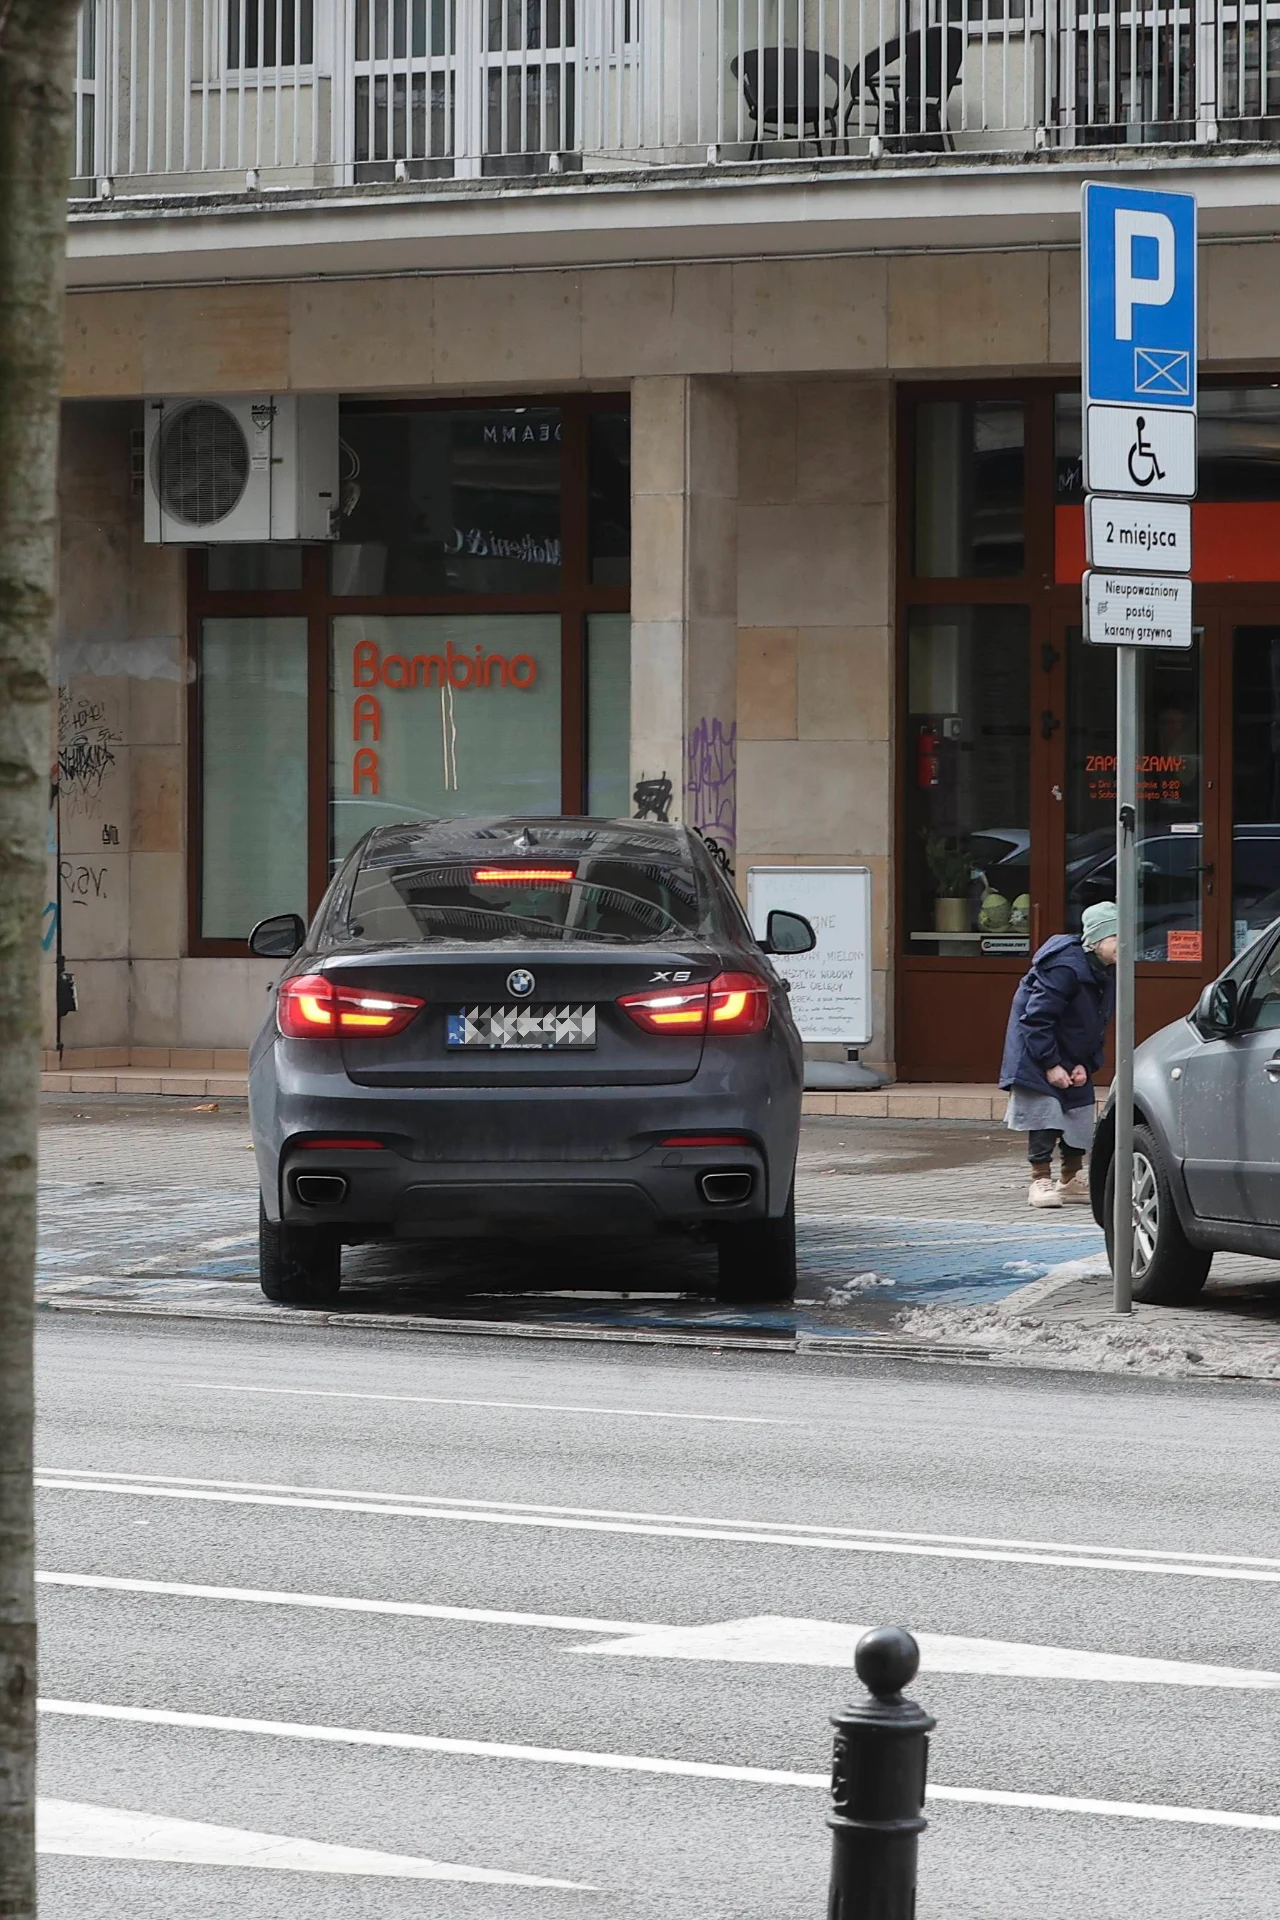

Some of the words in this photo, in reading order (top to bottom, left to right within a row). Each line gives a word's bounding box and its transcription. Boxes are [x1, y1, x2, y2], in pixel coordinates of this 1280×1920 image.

[1115, 208, 1175, 341] P
[1106, 521, 1114, 543] 2
[1120, 523, 1176, 551] miejsca
[1105, 580, 1179, 601] Nieupoważniony
[1125, 605, 1154, 621] postój
[1105, 622, 1135, 640] karany
[1137, 627, 1172, 641] grzywną
[353, 640, 537, 688] Bambino
[648, 971, 692, 983] X6
